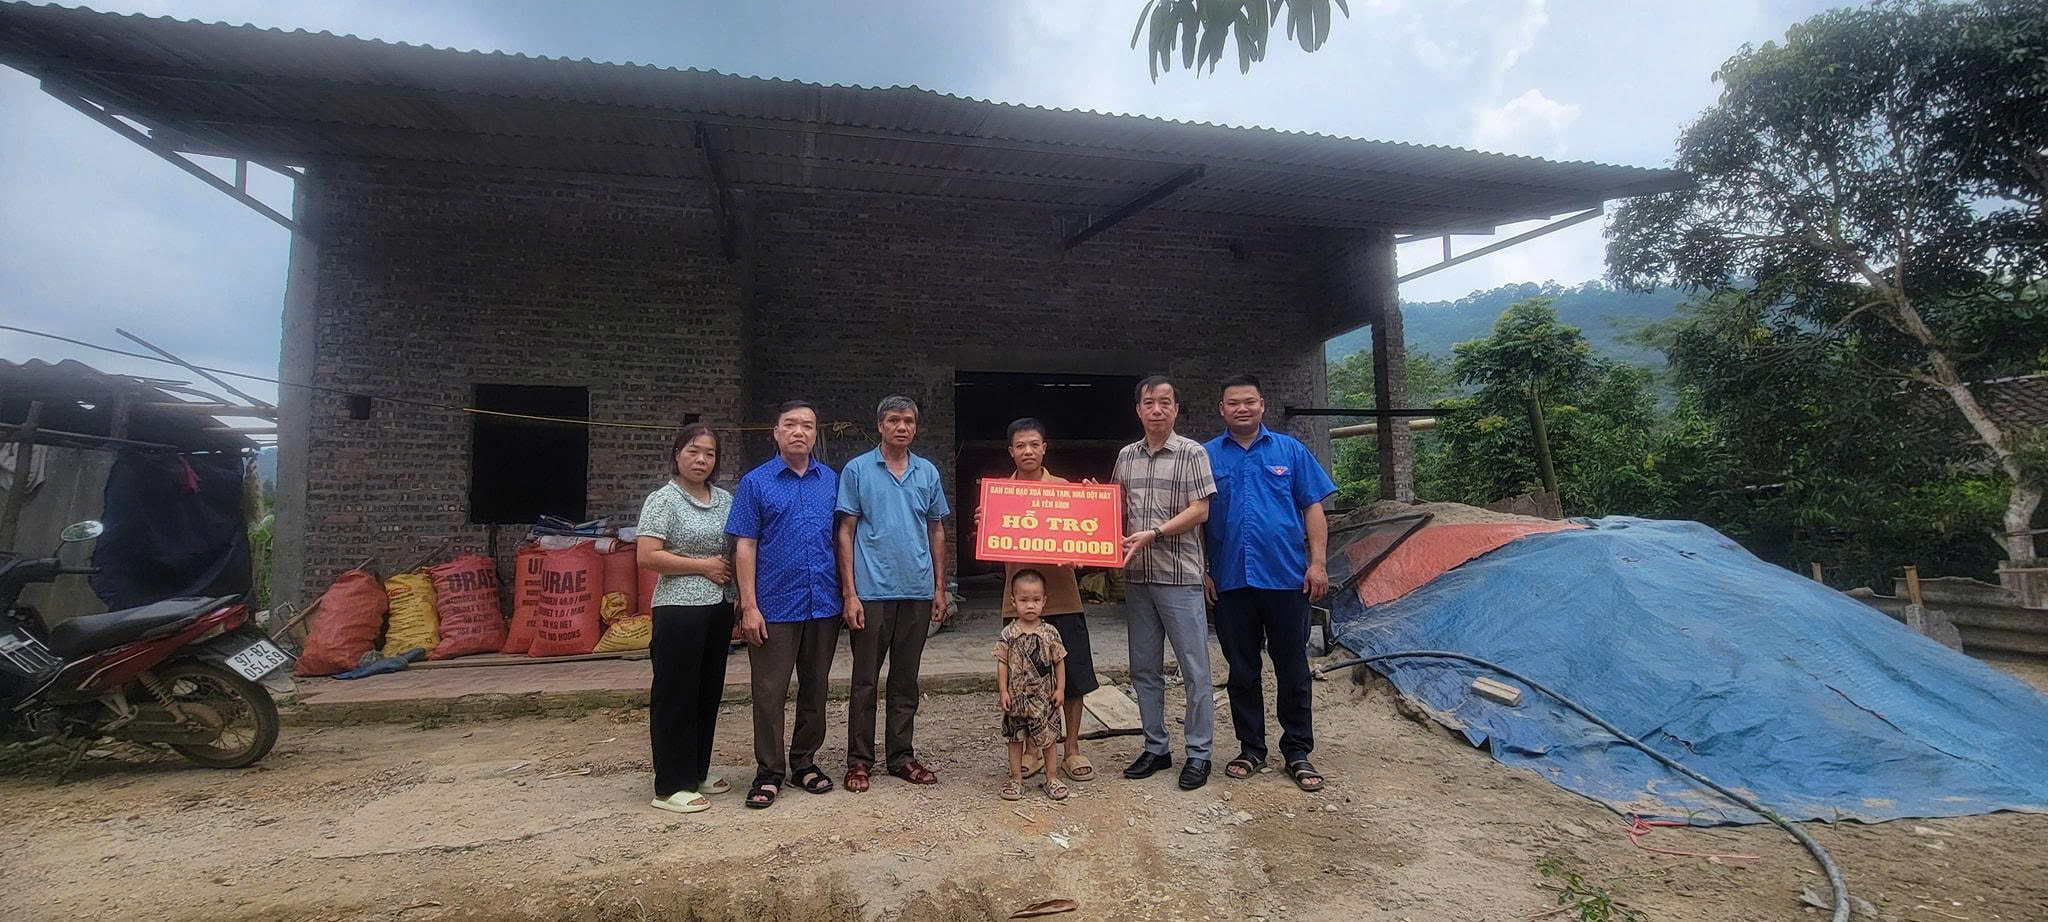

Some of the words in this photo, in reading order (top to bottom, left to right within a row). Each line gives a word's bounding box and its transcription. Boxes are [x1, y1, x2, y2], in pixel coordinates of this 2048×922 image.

[990, 486, 1003, 494] BAN
[1031, 499, 1041, 508] XÃ
[1041, 499, 1053, 508] YÊN
[1001, 509, 1039, 530] HỖ
[1045, 517, 1099, 536] TRỢ
[987, 535, 1114, 555] 60.000.000Đ
[542, 569, 588, 594] URAE
[549, 620, 559, 630] KG
[559, 620, 572, 629] NET
[548, 632, 557, 641] NO
[558, 629, 581, 641] HOOKS
[244, 651, 285, 678] 054.69
